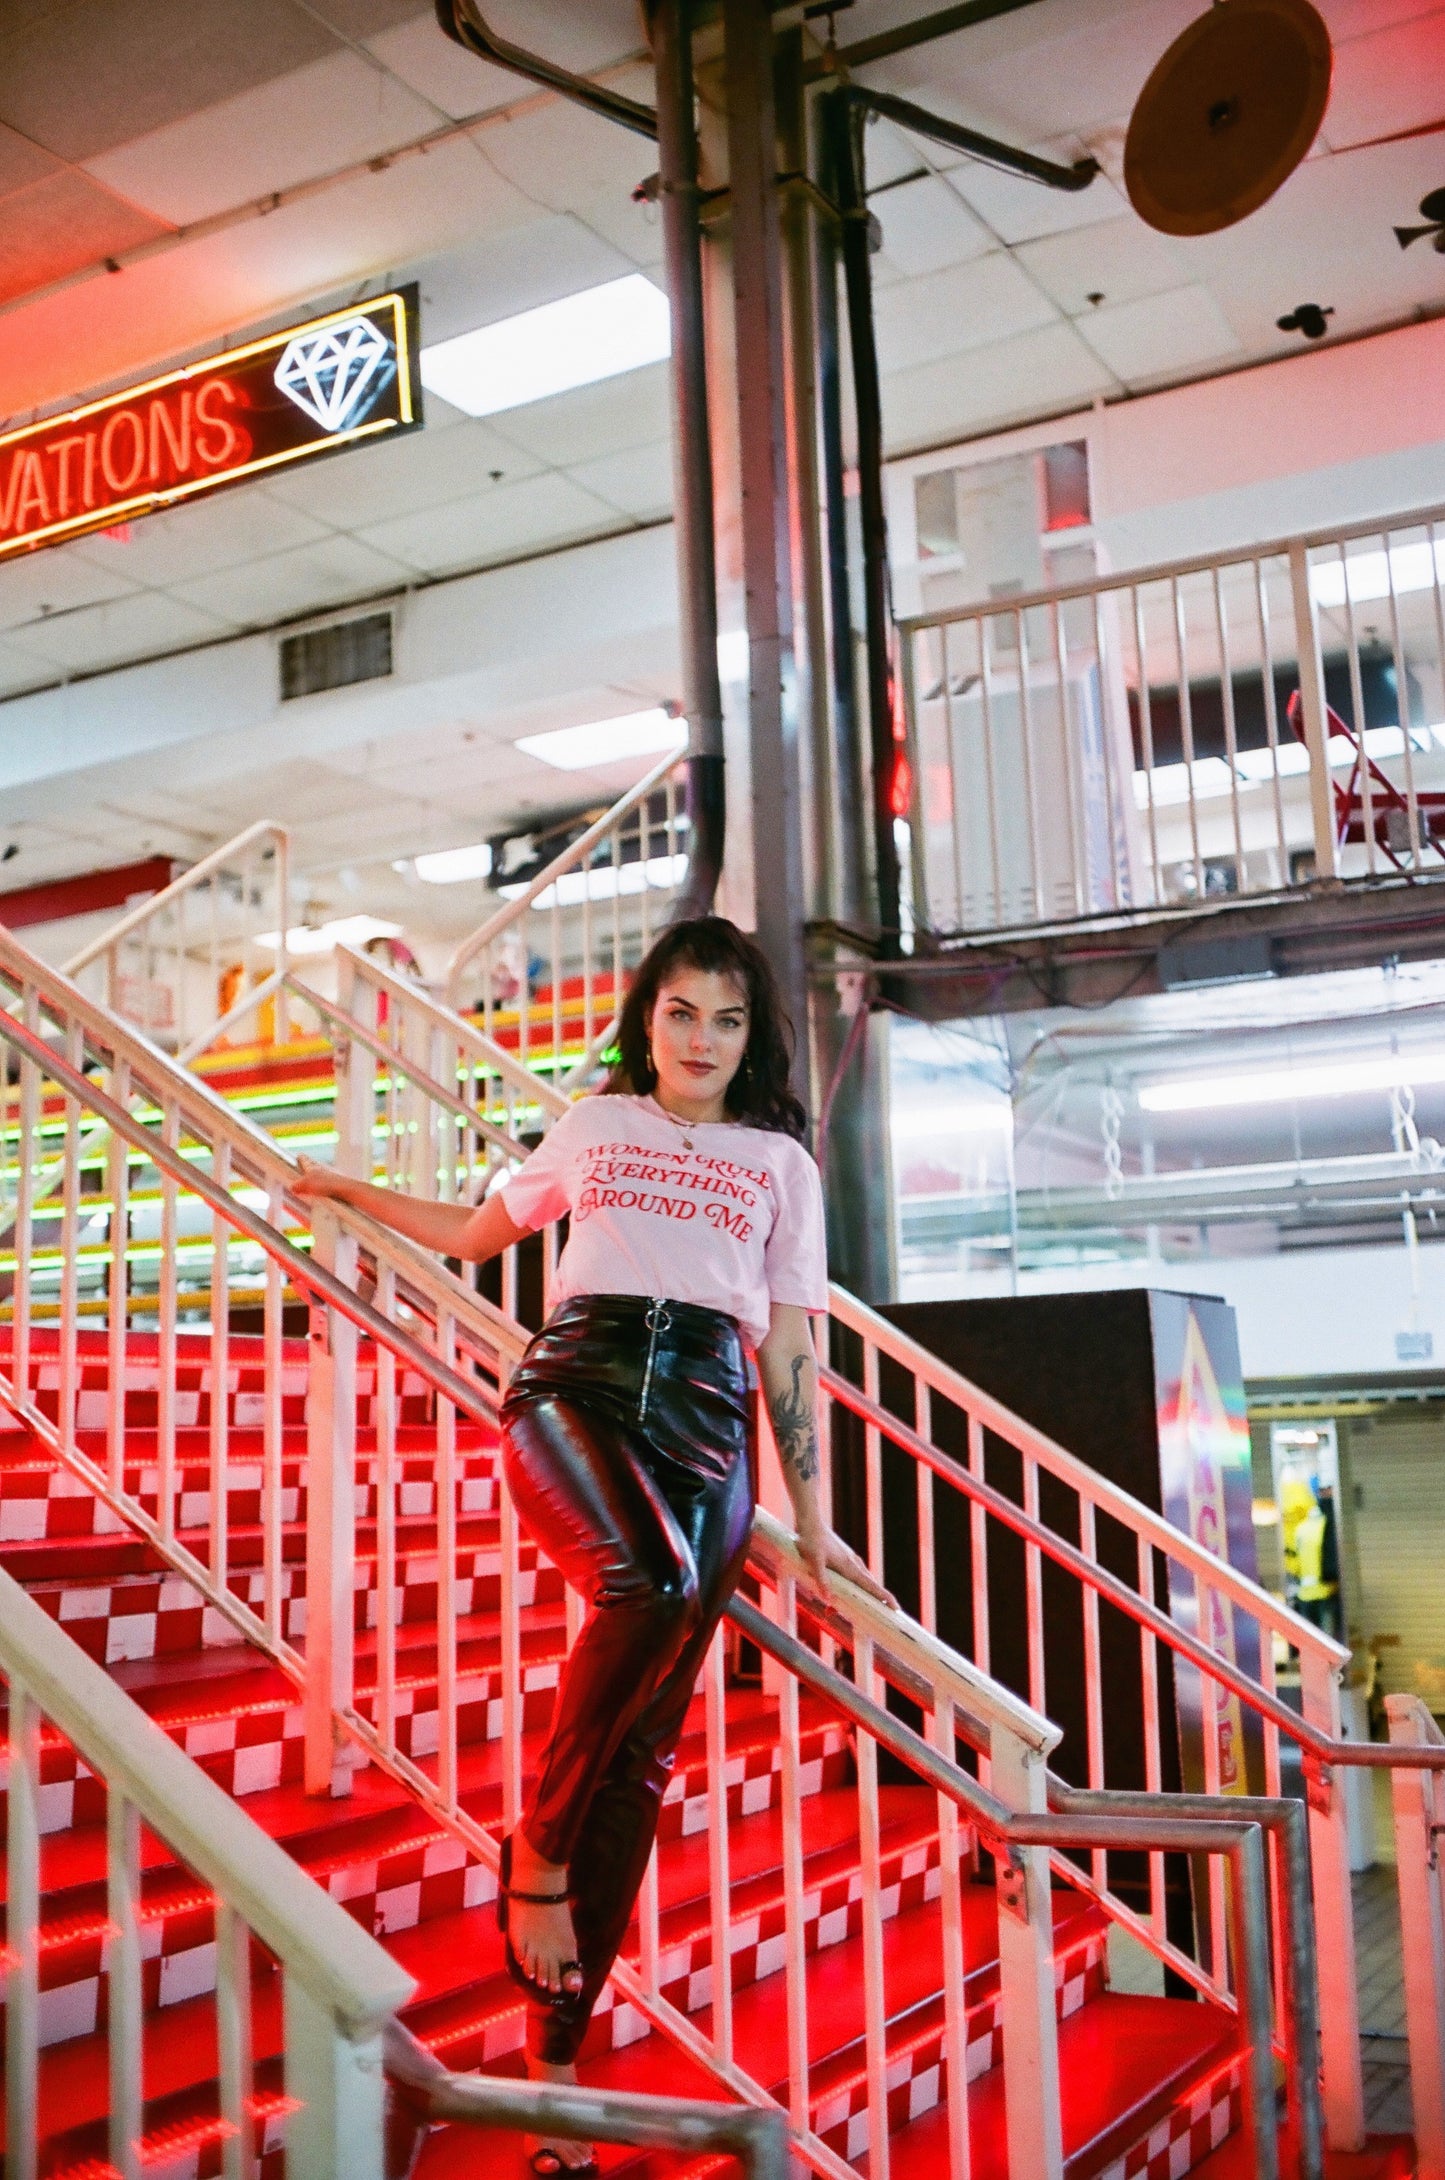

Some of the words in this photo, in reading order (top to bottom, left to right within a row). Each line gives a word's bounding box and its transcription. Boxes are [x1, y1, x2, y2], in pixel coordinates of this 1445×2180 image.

[576, 1142, 690, 1165] WOMEN
[695, 1154, 770, 1190] RULE
[581, 1158, 757, 1208] EVERYTHING
[575, 1187, 697, 1222] AROUND
[704, 1202, 754, 1244] ME
